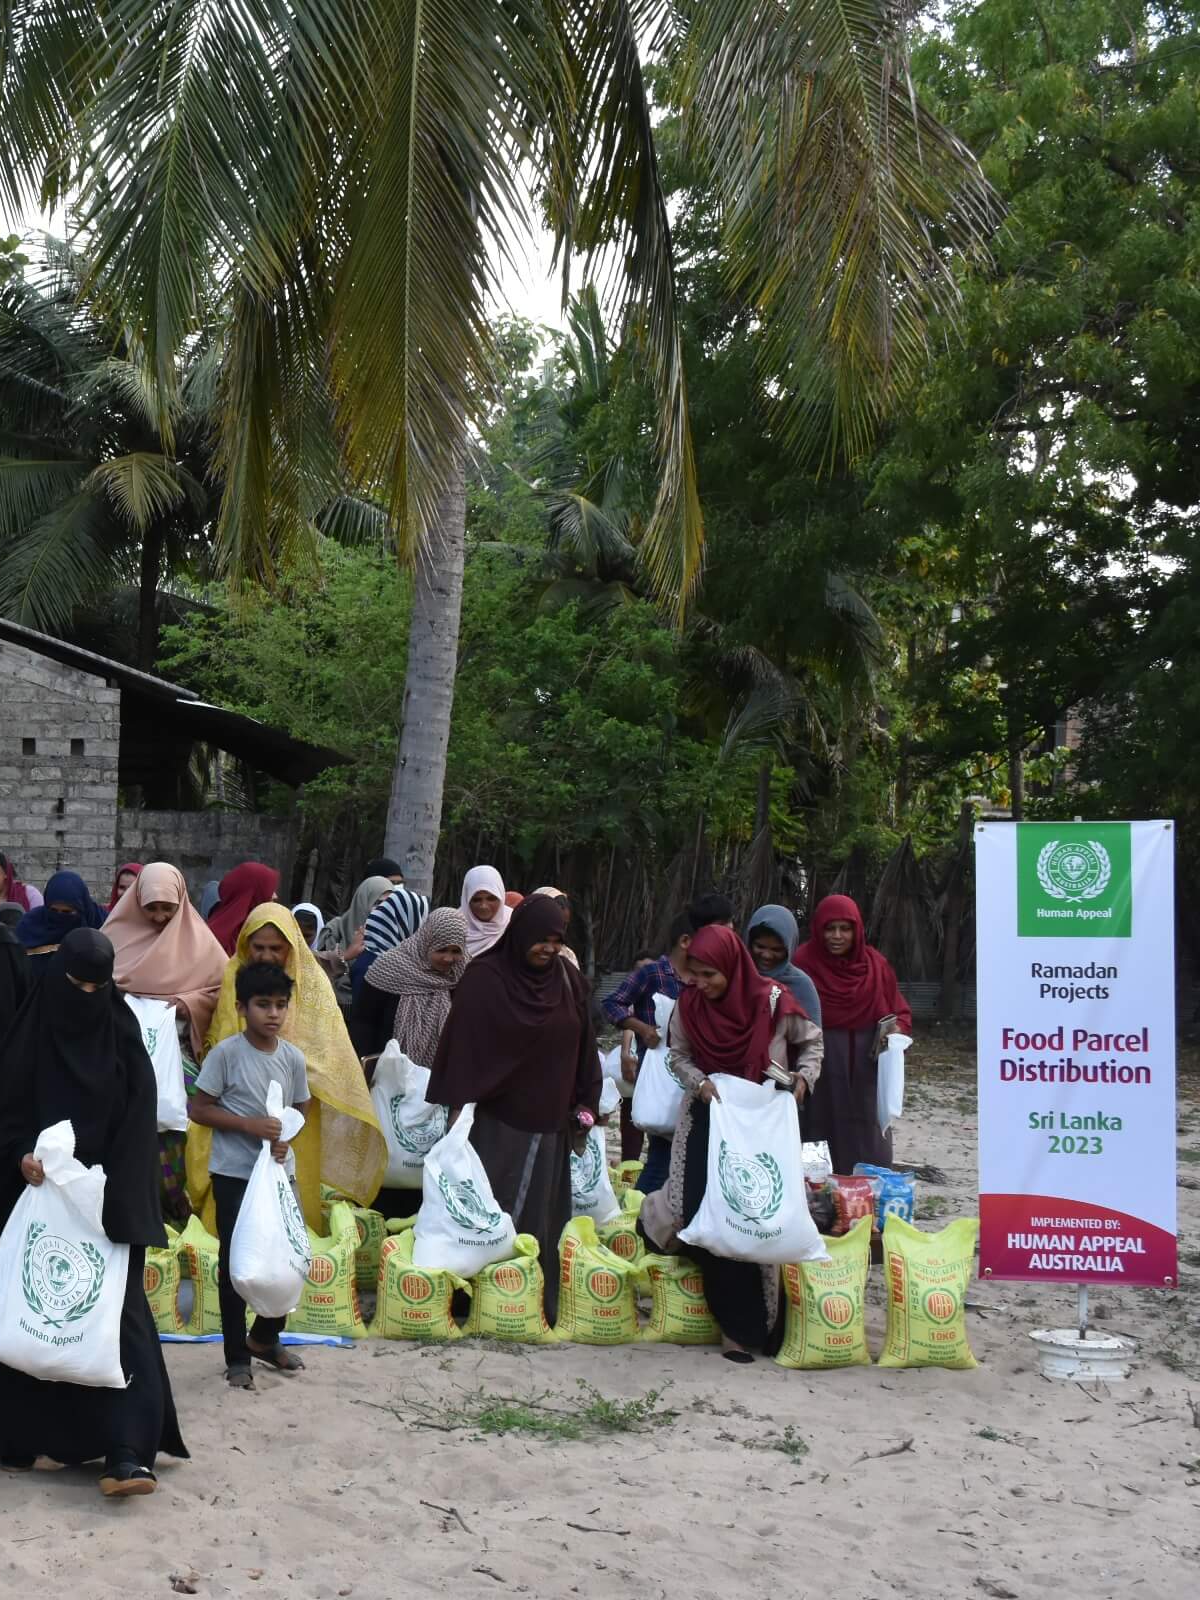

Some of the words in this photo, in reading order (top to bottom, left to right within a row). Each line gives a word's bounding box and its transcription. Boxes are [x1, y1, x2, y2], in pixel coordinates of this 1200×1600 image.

[1036, 908, 1074, 918] Human
[1076, 907, 1113, 920] Appeal
[1031, 962, 1117, 979] Ramadan
[1040, 983, 1109, 1003] Projects
[1002, 1026, 1064, 1051] Food
[1072, 1027, 1149, 1052] Parcel
[1000, 1058, 1152, 1083] Distribution
[1028, 1111, 1054, 1129] Sri
[1060, 1111, 1122, 1131] Lanka
[1048, 1135, 1103, 1154] 2023
[726, 1215, 752, 1236] Human
[754, 1226, 782, 1240] Appeal
[1031, 1216, 1102, 1229] IMPLEMENTED
[1104, 1219, 1121, 1230] BY:
[459, 1237, 486, 1247] Human
[1007, 1233, 1075, 1250] HUMAN
[1079, 1236, 1146, 1254] APPEAL
[1028, 1253, 1124, 1273] AUSTRALIA
[891, 1256, 903, 1304] IBRA
[36, 1279, 82, 1307] AUSTRALIA
[308, 1295, 334, 1304] 10KG
[403, 1310, 430, 1319] 10KG
[498, 1304, 525, 1313] 10KG
[593, 1308, 620, 1317] 10KG
[19, 1318, 49, 1343] Human
[51, 1332, 84, 1346] Appeal
[826, 1336, 853, 1345] 10KG
[931, 1331, 956, 1340] 10KG
